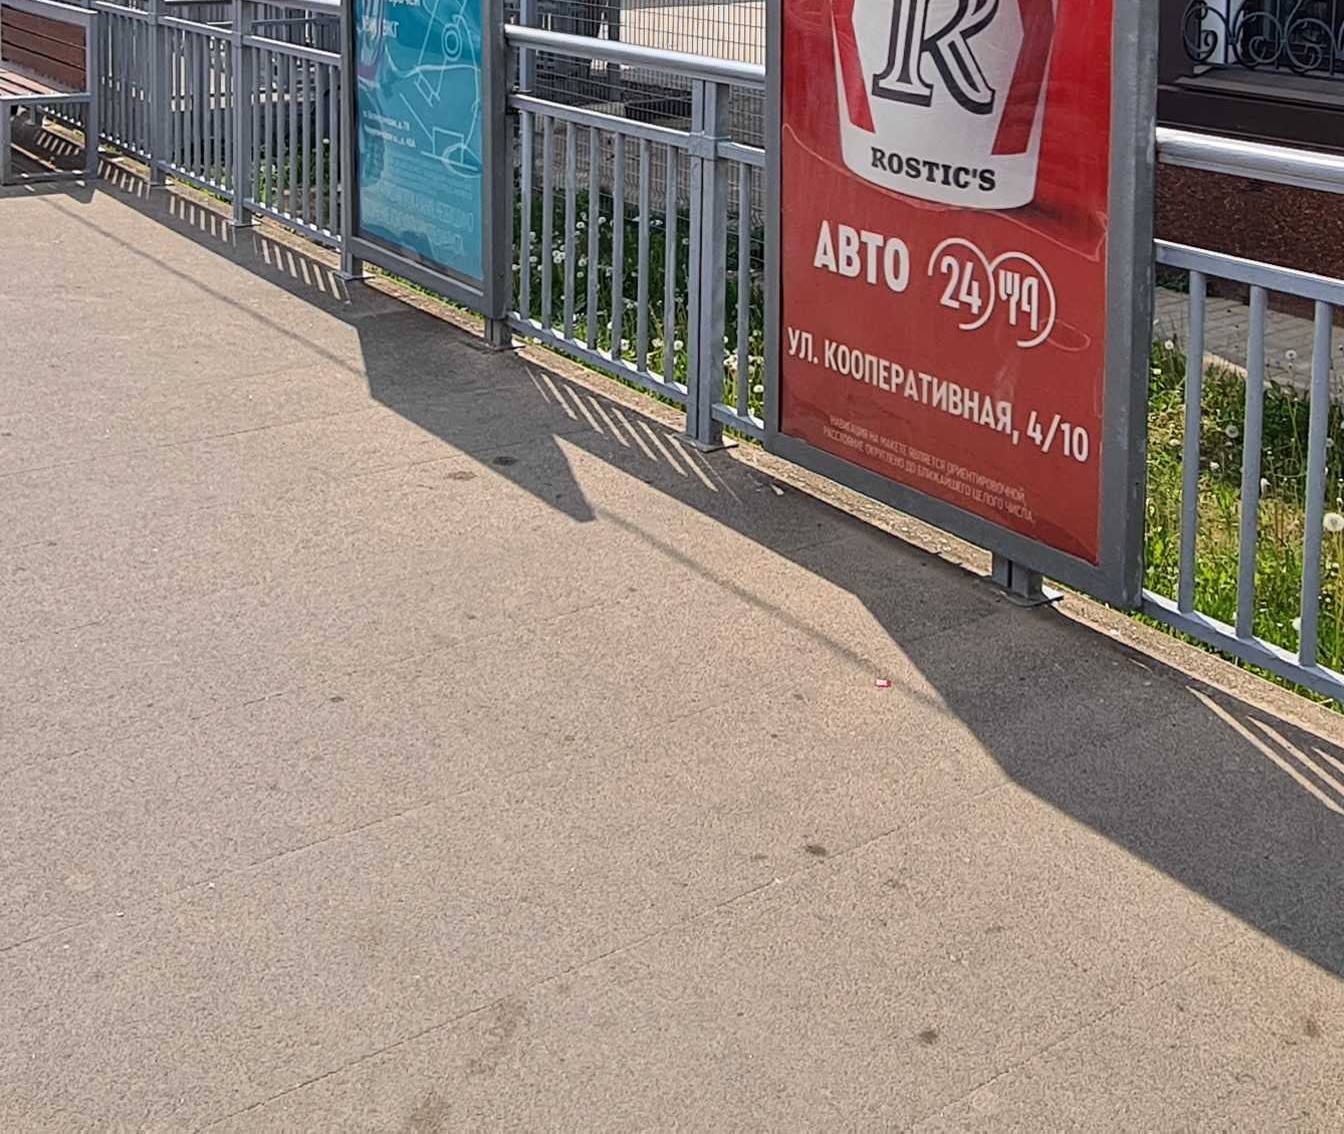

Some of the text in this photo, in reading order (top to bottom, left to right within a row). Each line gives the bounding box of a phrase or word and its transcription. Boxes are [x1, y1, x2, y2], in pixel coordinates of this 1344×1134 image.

[870, 146, 997, 192] ROSTIC'S
[813, 219, 983, 316] АВТО 24
[787, 326, 1089, 463] УЛ. КООПЕРАТИВНАЯ, 4/10
